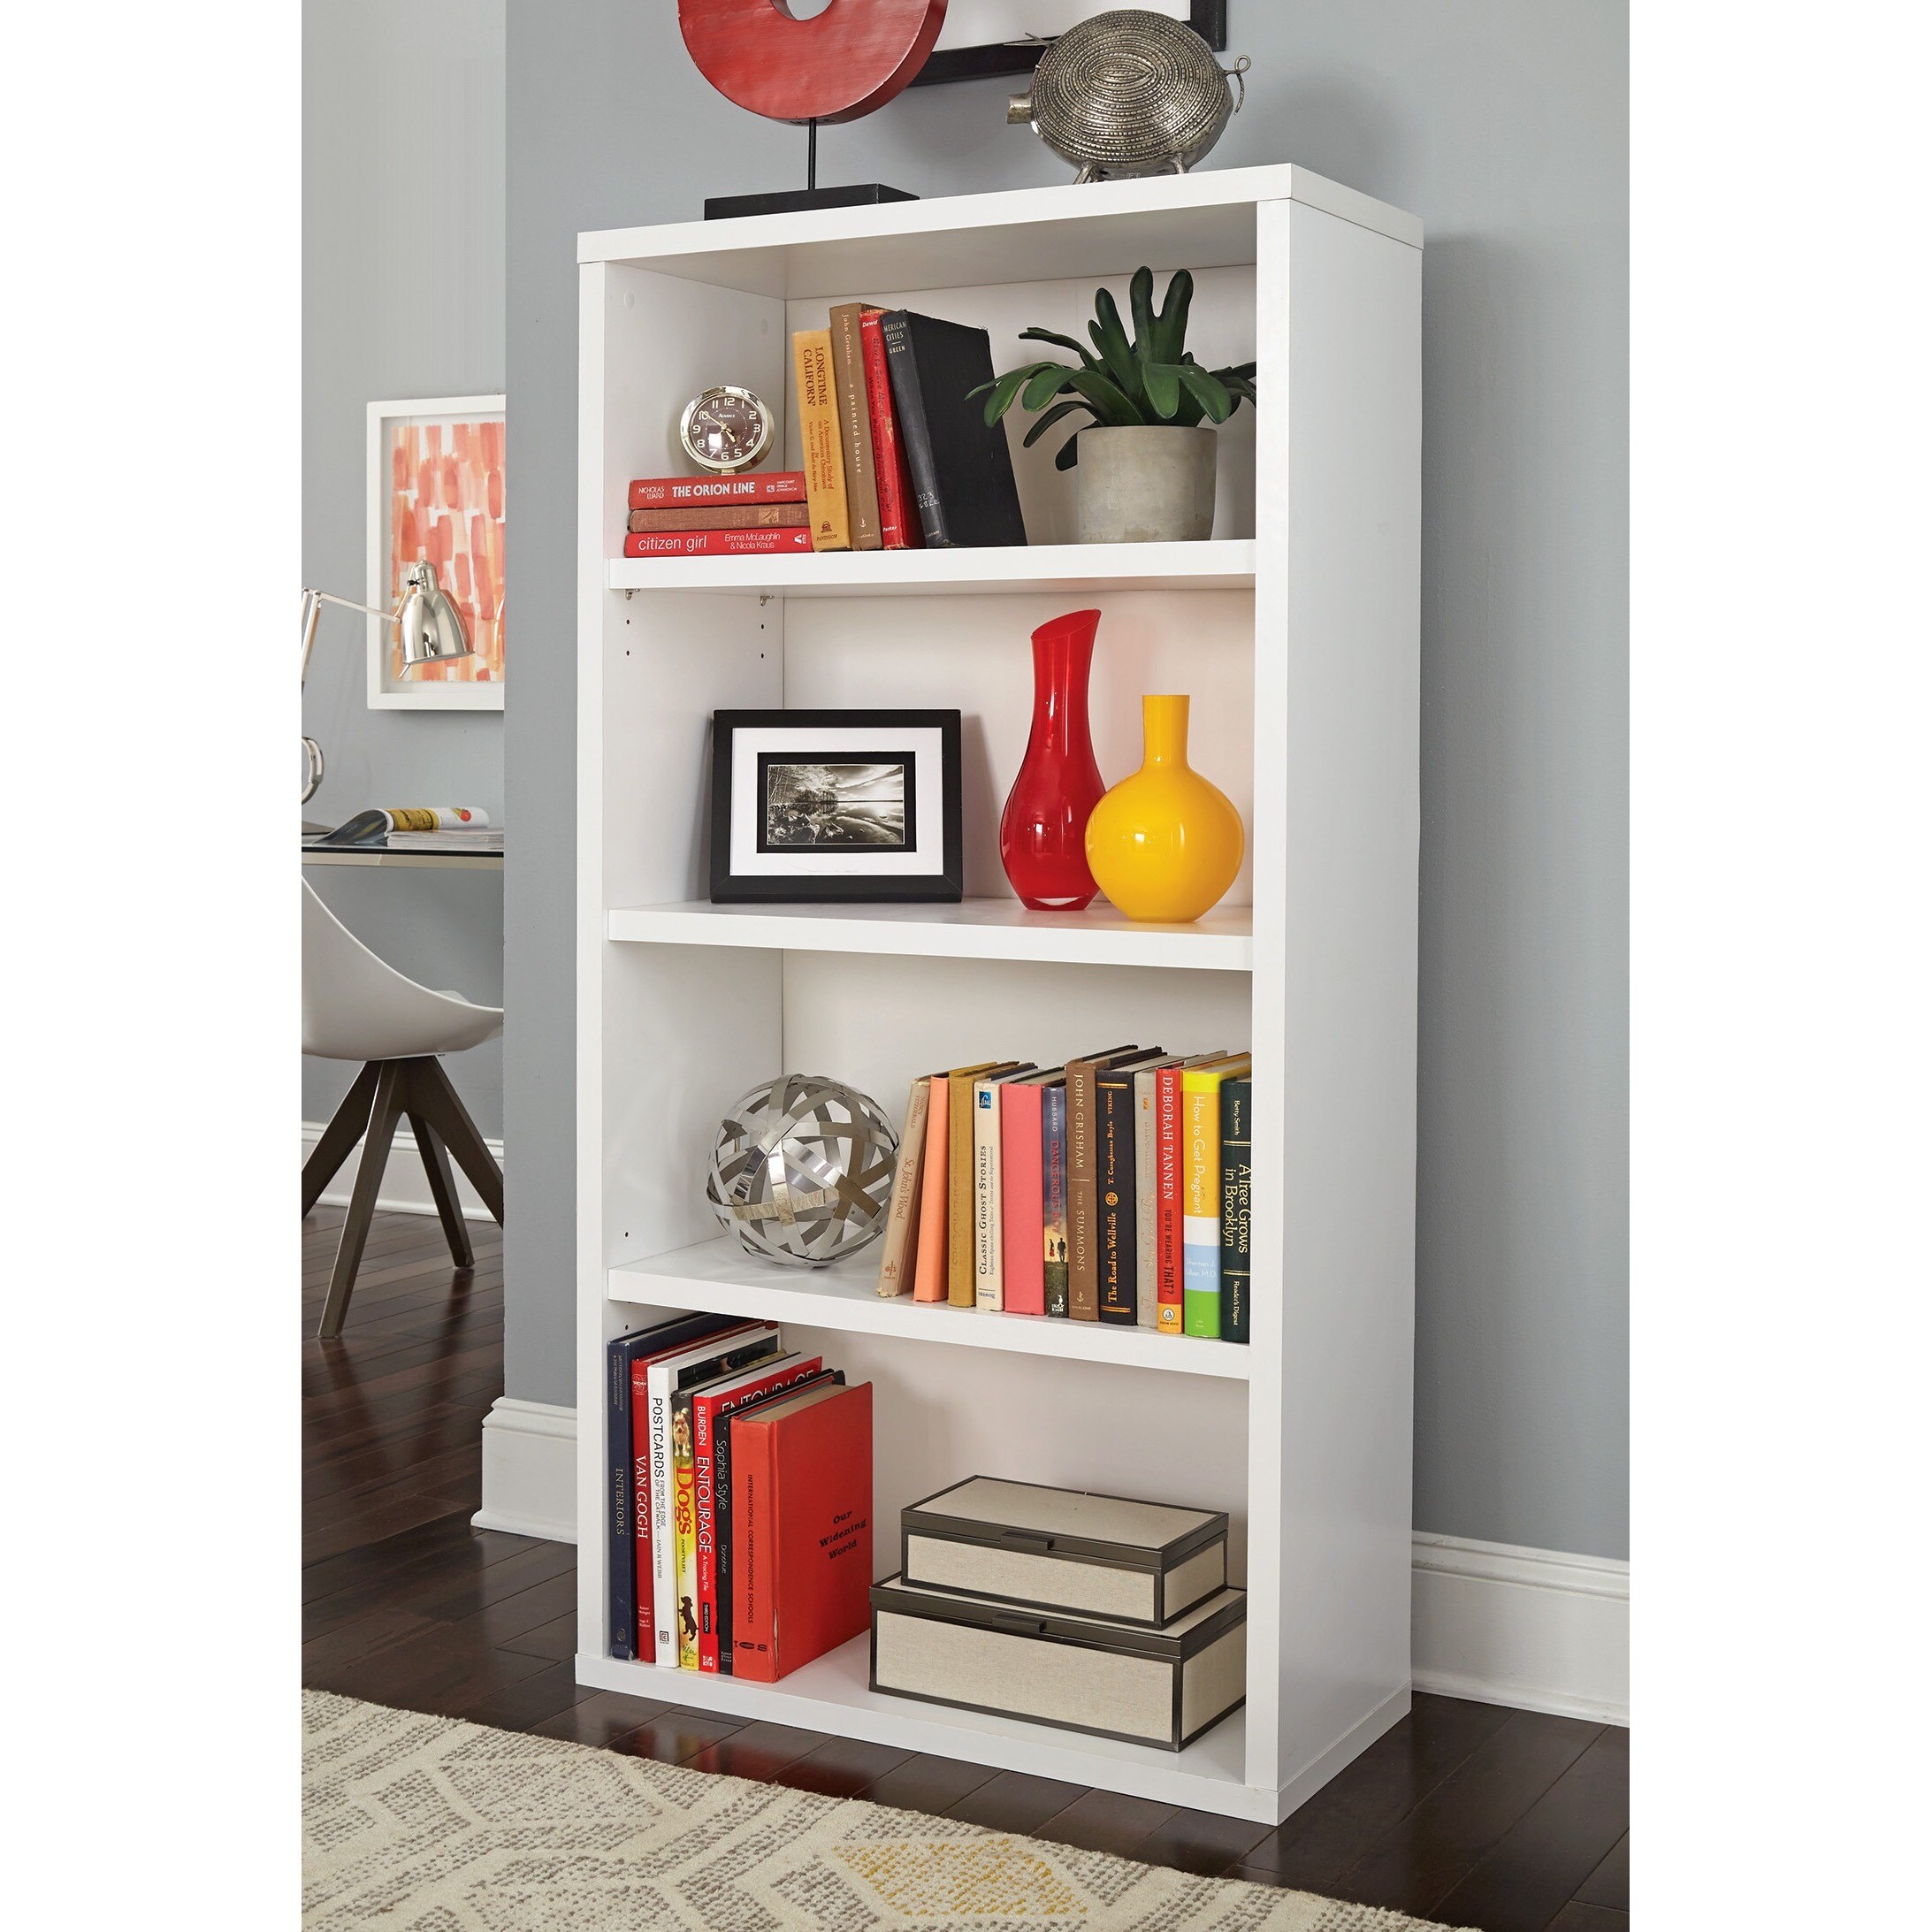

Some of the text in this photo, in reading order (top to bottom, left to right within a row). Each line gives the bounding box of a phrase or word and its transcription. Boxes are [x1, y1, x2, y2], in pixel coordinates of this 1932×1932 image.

[883, 321, 906, 332] MERICAN
[886, 332, 904, 341] CITIES
[890, 345, 905, 354] GREEN
[815, 347, 828, 406] LONGTIME
[693, 424, 700, 433] 9
[699, 411, 709, 420] 10
[753, 424, 760, 433] 3
[849, 394, 859, 436] painted
[697, 439, 706, 447] 8
[709, 449, 717, 458] 7
[746, 439, 754, 447] 4
[638, 485, 665, 494] NICHOLAS
[672, 485, 691, 498] THE
[693, 483, 730, 497] ORION
[733, 482, 755, 495] LINE
[638, 535, 707, 552] citizen girl
[746, 532, 780, 542] McLaughlin
[1073, 1073, 1084, 1107] JOHN
[1075, 1112, 1084, 1168] GRISHAM
[1163, 1077, 1173, 1200] DEBORAH TANNEN
[1191, 1096, 1206, 1213] How to Get Pregnant
[1050, 1141, 1060, 1208] DANGEROUS
[897, 1158, 914, 1220] St. John's Wood
[1223, 1168, 1238, 1247] in Brooklyn
[1239, 1164, 1251, 1253] A Tree Grows
[1107, 1212, 1117, 1249] Wellville
[1108, 1261, 1117, 1284] Road
[1164, 1266, 1174, 1294] THAT?
[1108, 1287, 1118, 1302] The
[653, 1398, 664, 1478] POSTCARDS
[698, 1406, 706, 1446] BURDEN
[715, 1439, 728, 1510] Sophia Style
[615, 1468, 624, 1535] INTERIORS
[637, 1455, 648, 1539] VAN GOGH
[676, 1468, 694, 1535] Dogs
[697, 1457, 712, 1554] ENTOURAGE
[833, 1510, 852, 1524] Our
[820, 1519, 867, 1547] Widening
[829, 1539, 857, 1560] World
